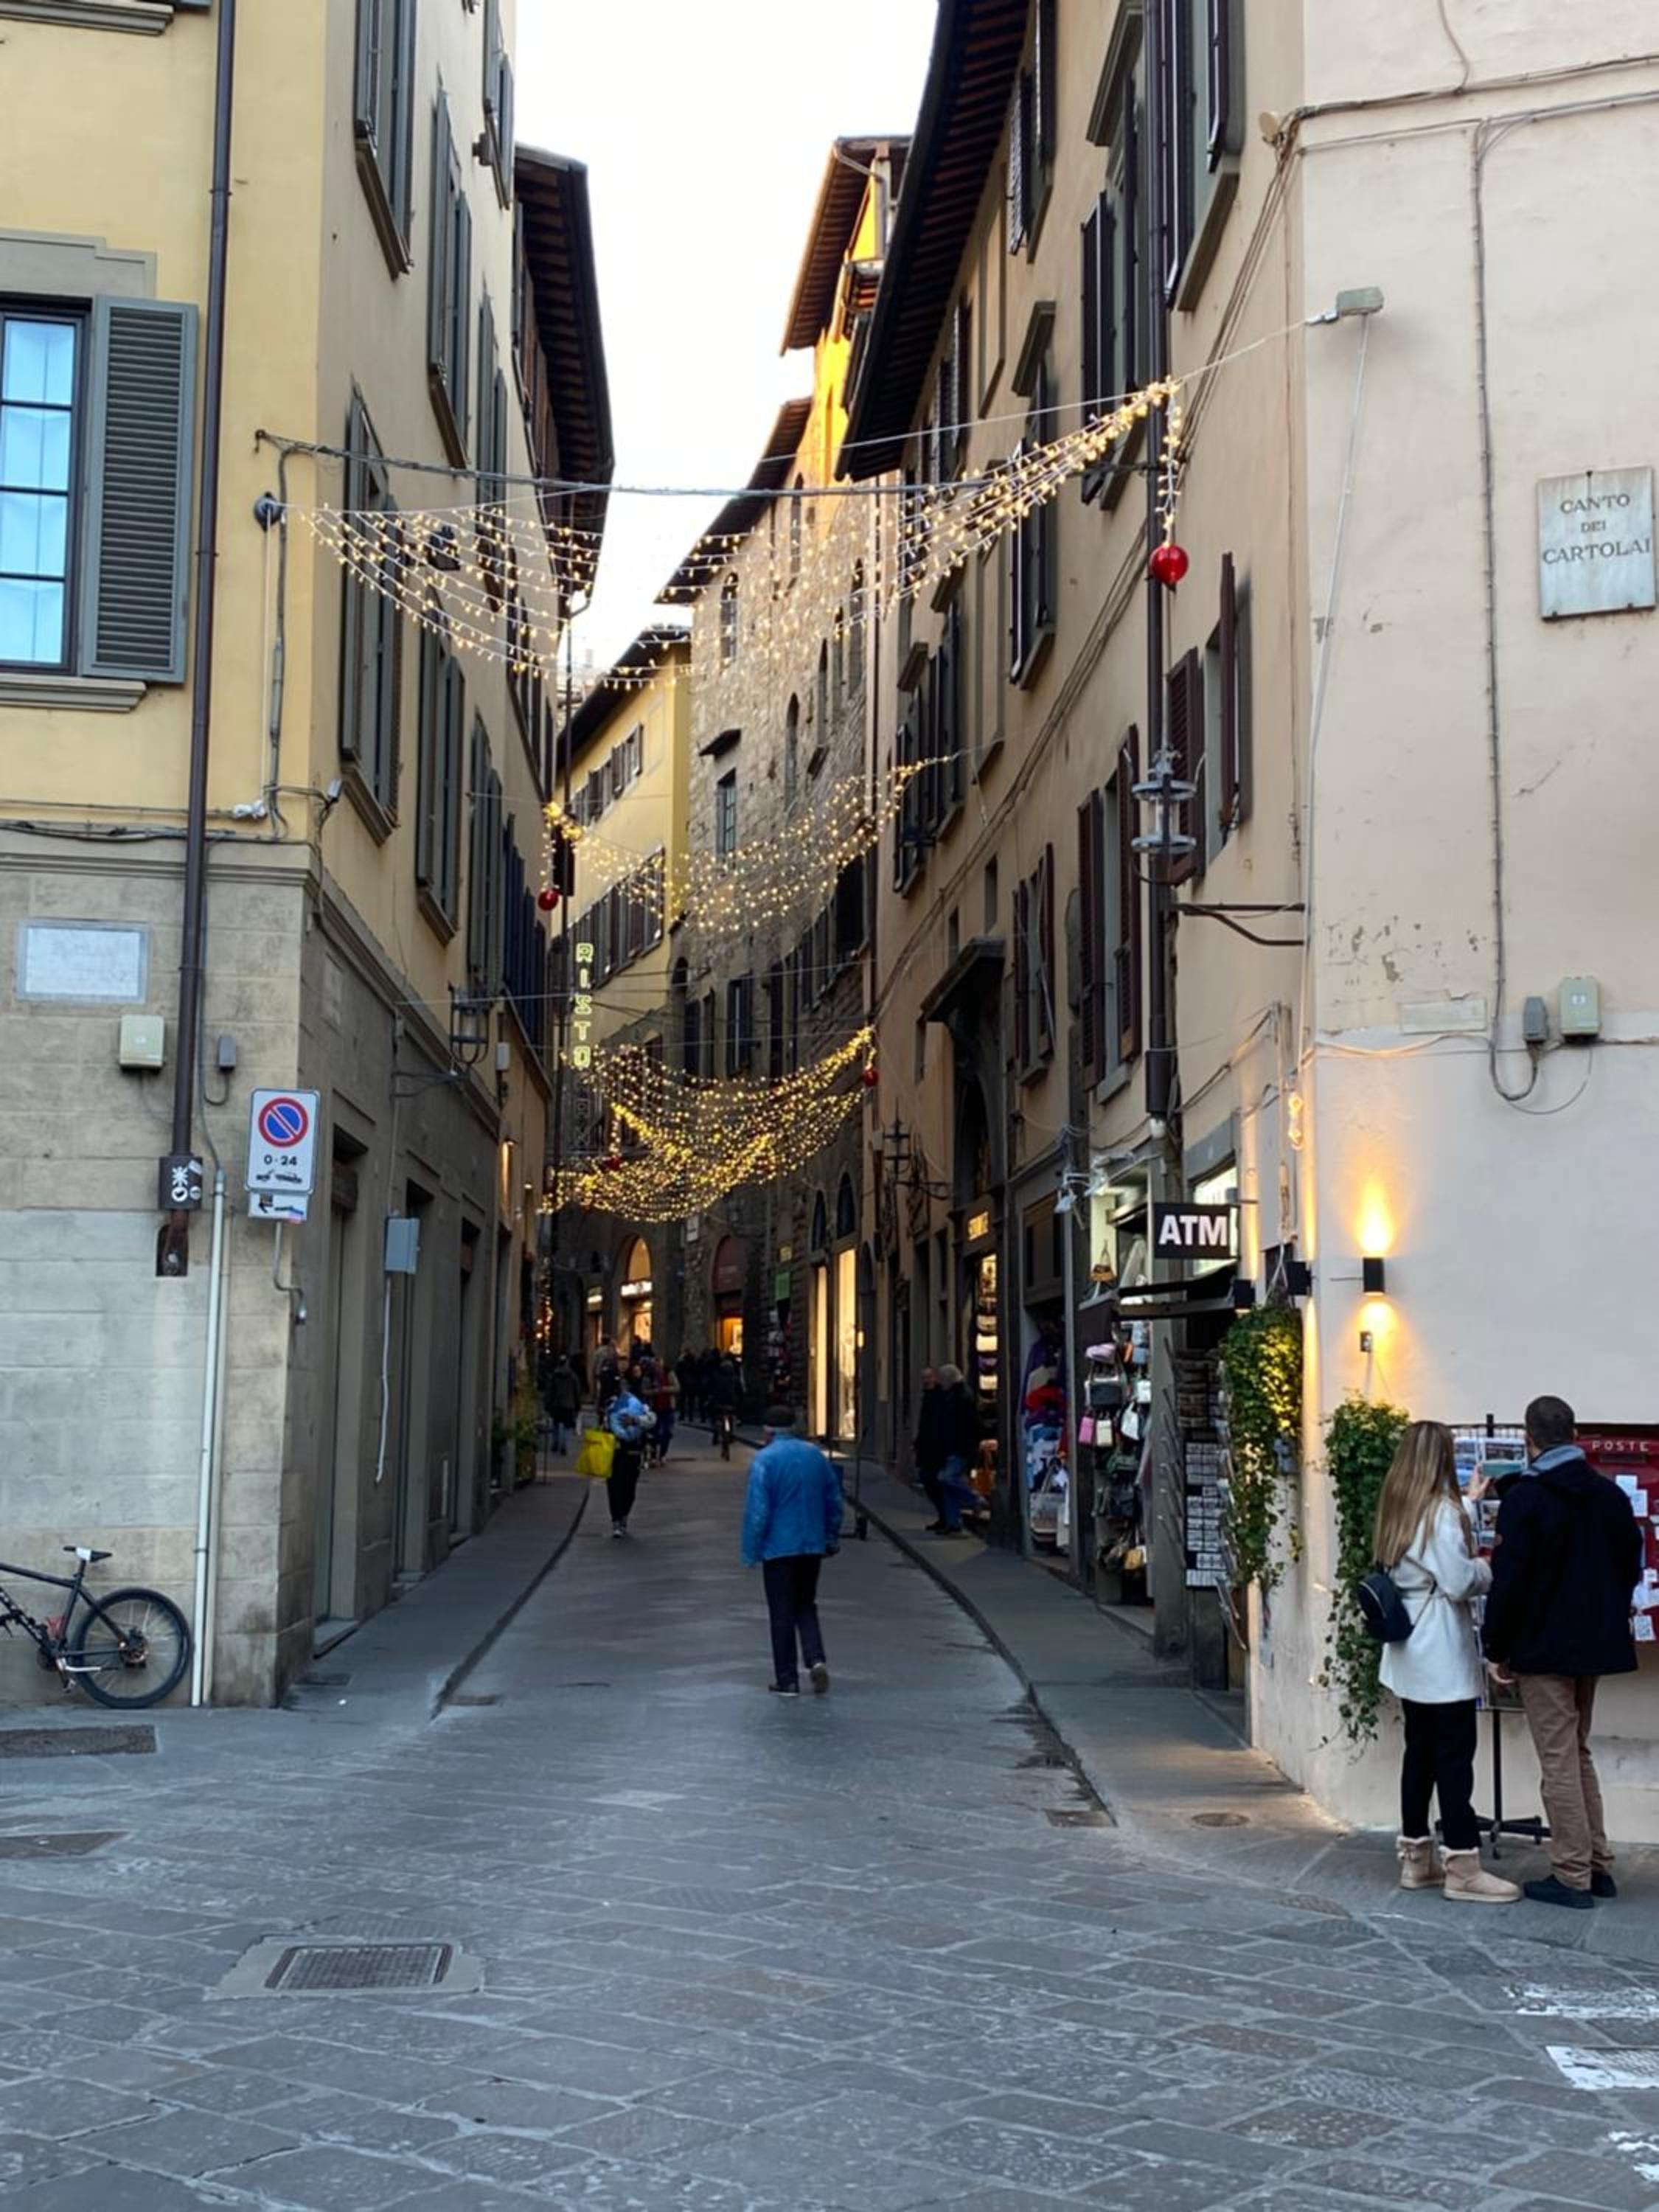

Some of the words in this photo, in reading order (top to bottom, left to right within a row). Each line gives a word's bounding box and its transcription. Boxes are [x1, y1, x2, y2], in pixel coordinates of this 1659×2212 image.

[1559, 493, 1631, 515] CANTO
[1580, 520, 1607, 533] DEI
[1542, 538, 1651, 565] CARTOLAI
[1158, 1214, 1228, 1246] ATM
[1592, 1439, 1649, 1452] POSTE
